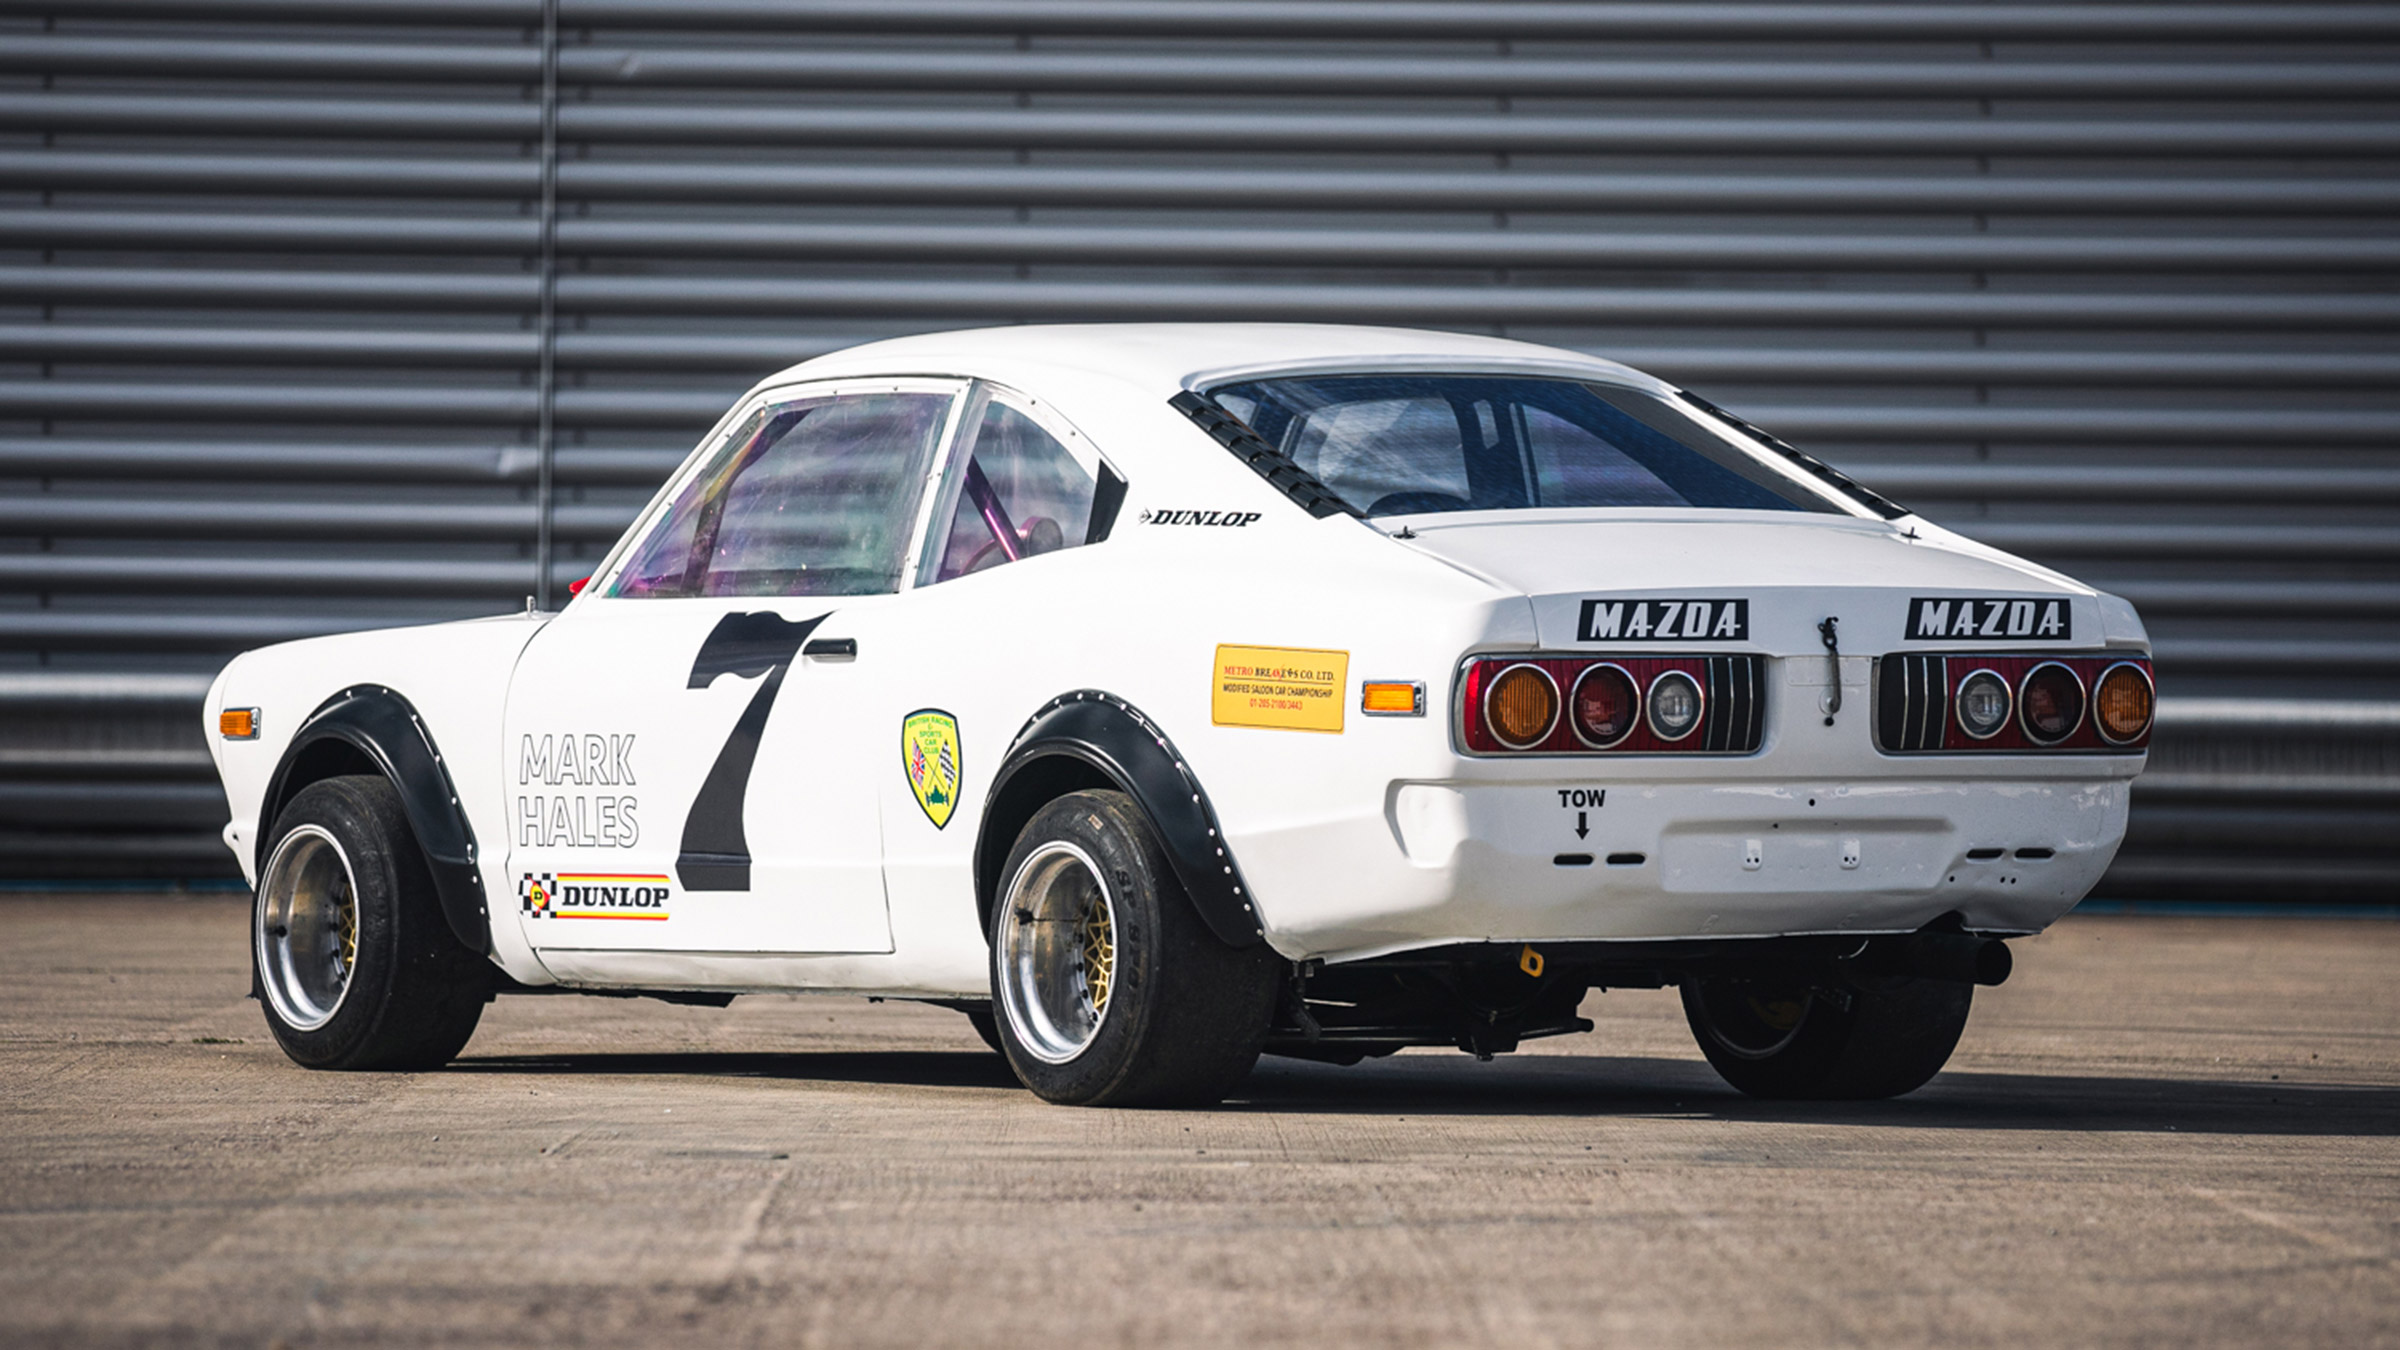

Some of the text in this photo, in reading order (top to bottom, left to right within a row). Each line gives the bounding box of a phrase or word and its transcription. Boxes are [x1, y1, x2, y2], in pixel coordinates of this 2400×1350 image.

[1149, 509, 1263, 527] DUNLOP
[1589, 602, 1742, 638] MAZDA
[1917, 601, 2065, 636] MAZDA
[1223, 665, 1254, 677] METRO
[519, 734, 637, 786] MARK
[675, 608, 841, 892] 7
[1557, 789, 1606, 808] TOW
[518, 796, 640, 848] HALES
[562, 886, 669, 908] DUNLOP
